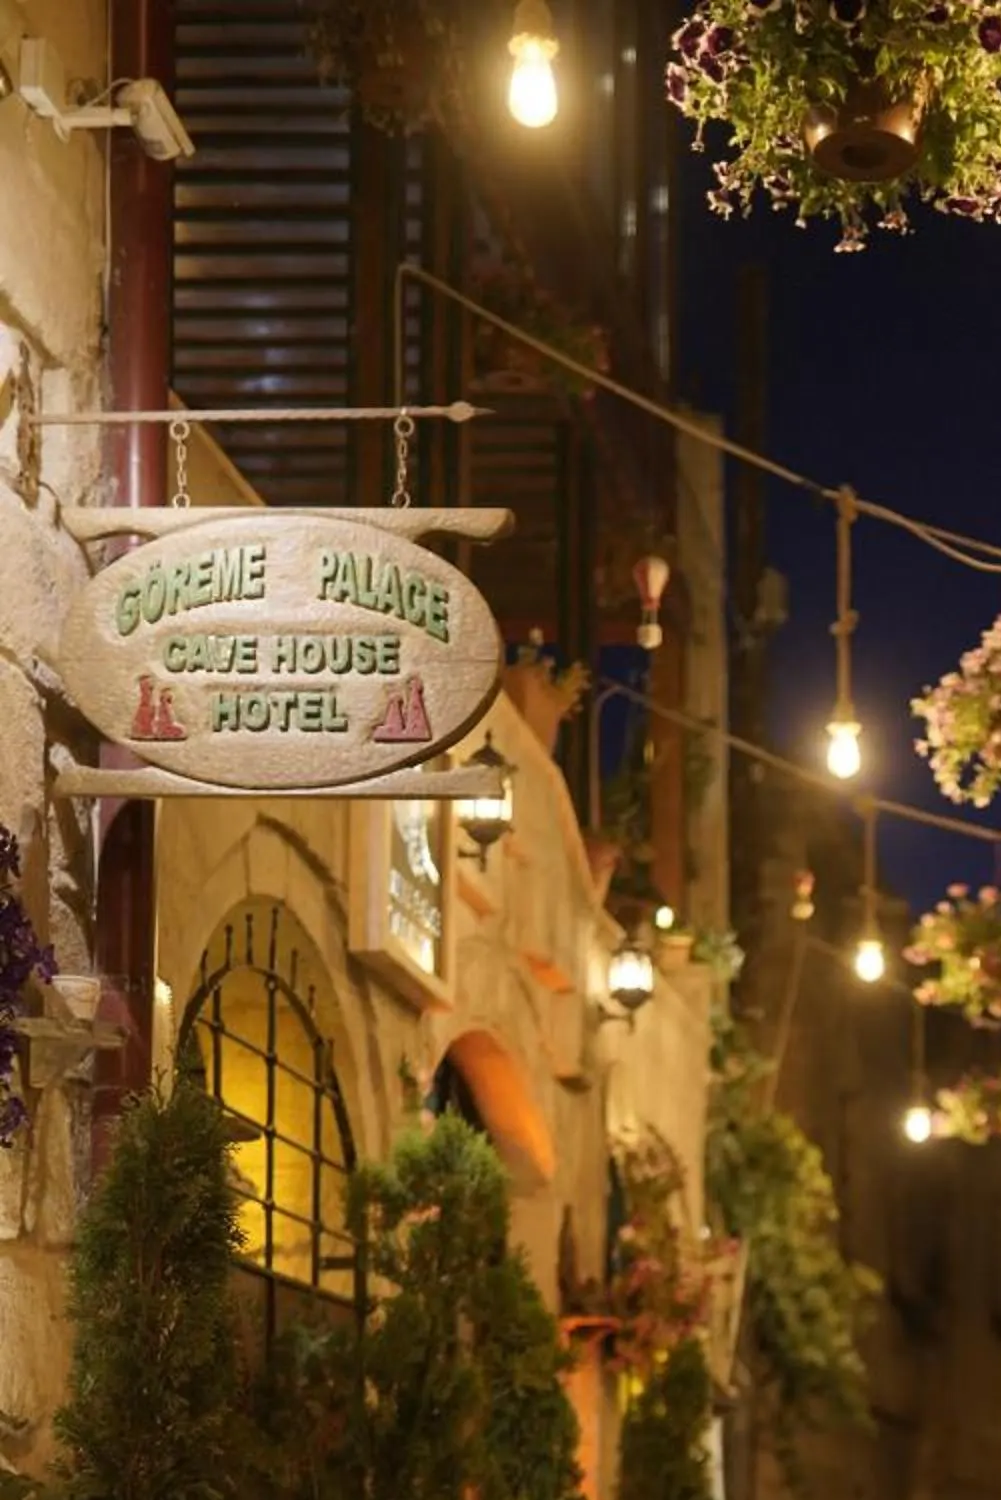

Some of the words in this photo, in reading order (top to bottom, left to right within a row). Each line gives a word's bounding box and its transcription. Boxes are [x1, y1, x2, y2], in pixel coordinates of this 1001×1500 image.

[115, 544, 266, 637] GÖREME
[316, 546, 449, 644] PALACE
[163, 634, 258, 673] CAVE
[271, 634, 400, 675] HOUSE
[212, 690, 349, 732] HOTEL
